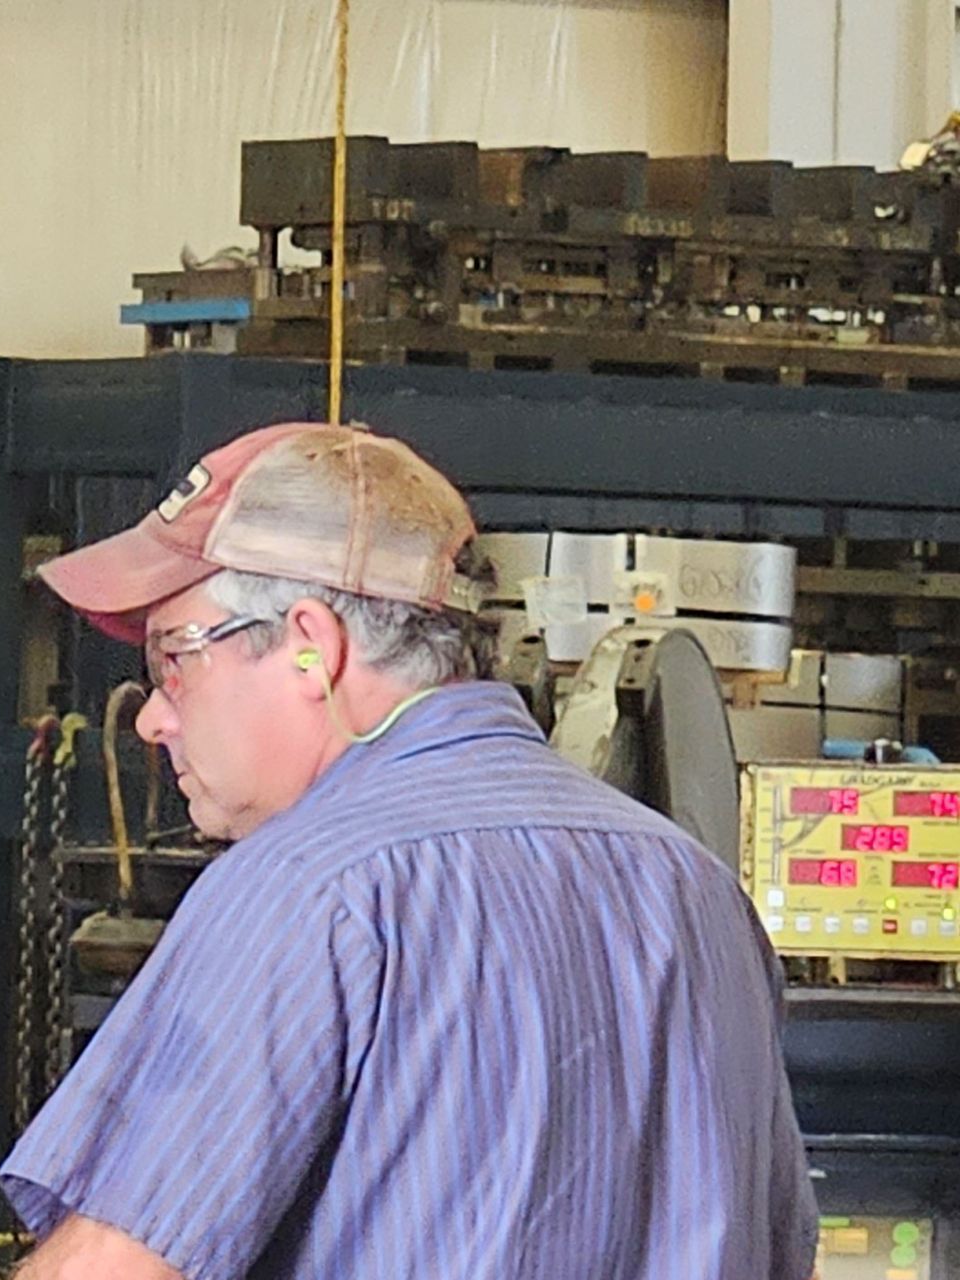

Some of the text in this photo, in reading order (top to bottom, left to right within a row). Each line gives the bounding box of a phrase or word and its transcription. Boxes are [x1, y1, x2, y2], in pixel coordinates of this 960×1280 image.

[827, 789, 858, 815] 75
[855, 826, 908, 852] 289
[927, 863, 958, 889] 72
